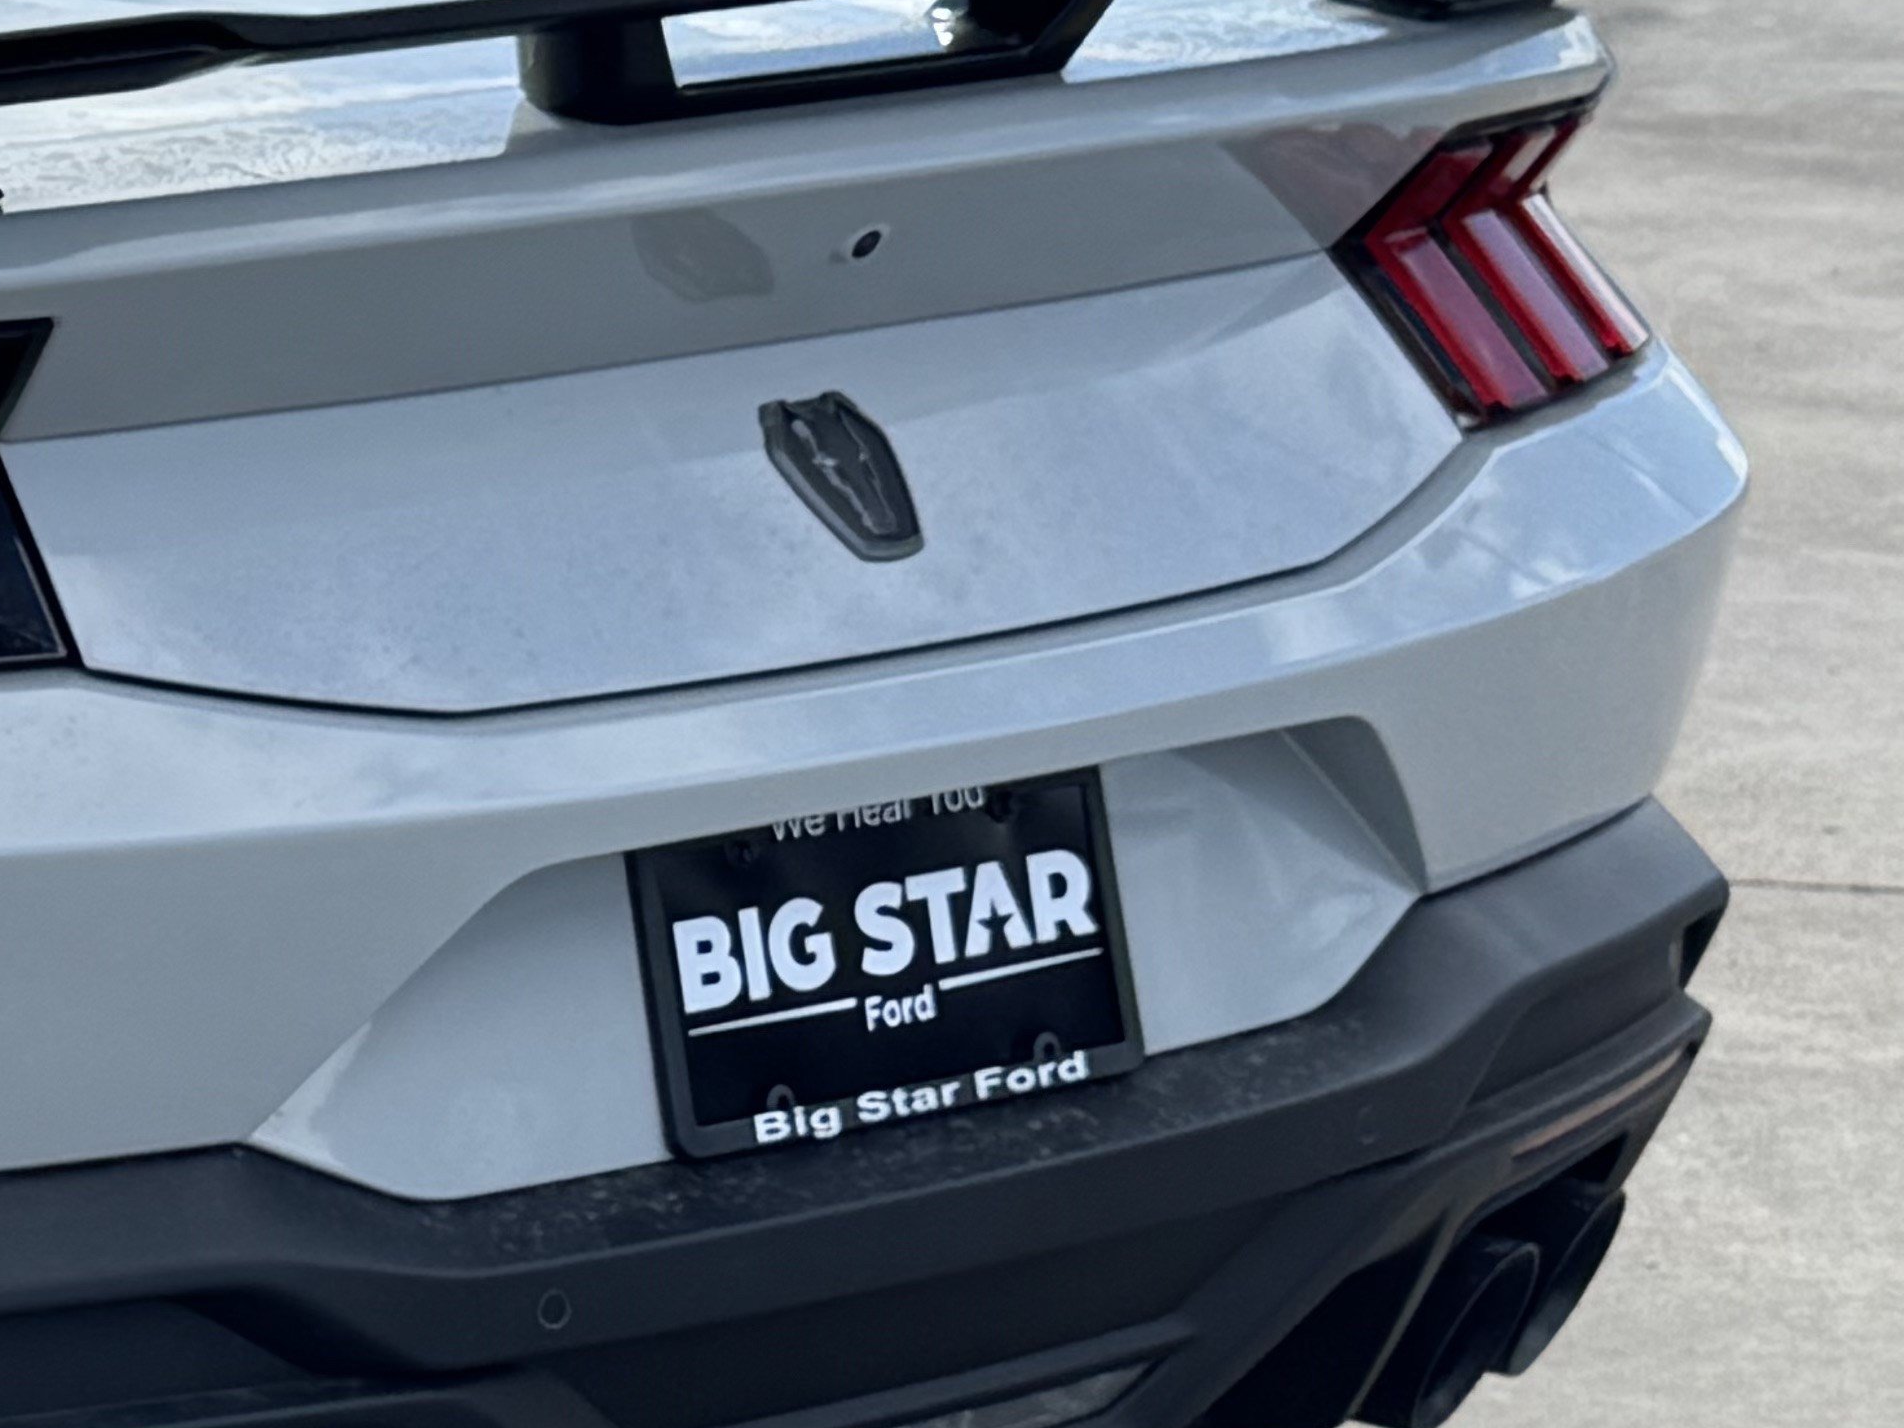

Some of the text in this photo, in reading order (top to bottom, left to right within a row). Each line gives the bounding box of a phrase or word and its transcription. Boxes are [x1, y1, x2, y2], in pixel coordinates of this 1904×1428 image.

[672, 849, 1098, 1014] BIG STAR
[864, 983, 937, 1031] Ford
[753, 1051, 1089, 1144] Big Star Ford
